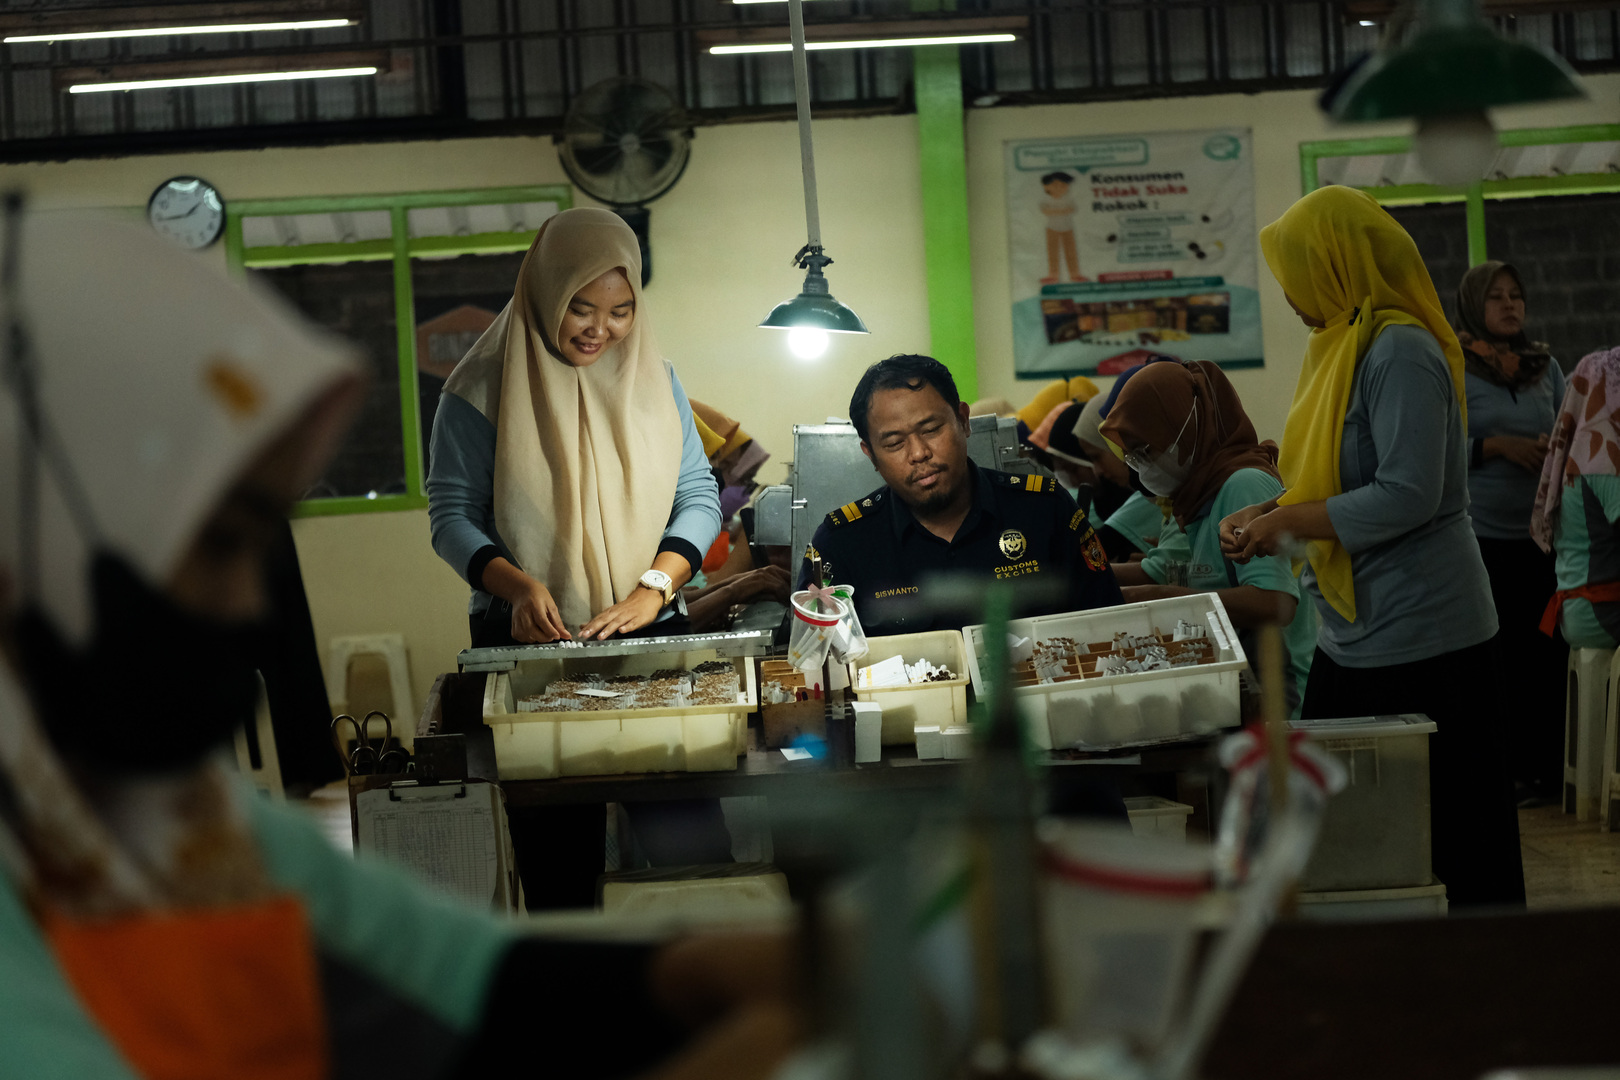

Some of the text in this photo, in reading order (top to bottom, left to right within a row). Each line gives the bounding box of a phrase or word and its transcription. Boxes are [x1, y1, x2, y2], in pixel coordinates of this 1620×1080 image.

[1091, 171, 1184, 184] Konsumen
[1092, 185, 1188, 198] Tidak Suka
[1093, 200, 1148, 212] Rokok
[994, 559, 1039, 574] CUSTOMS
[996, 566, 1041, 580] EXCISE
[874, 586, 919, 599] SISWANTO
